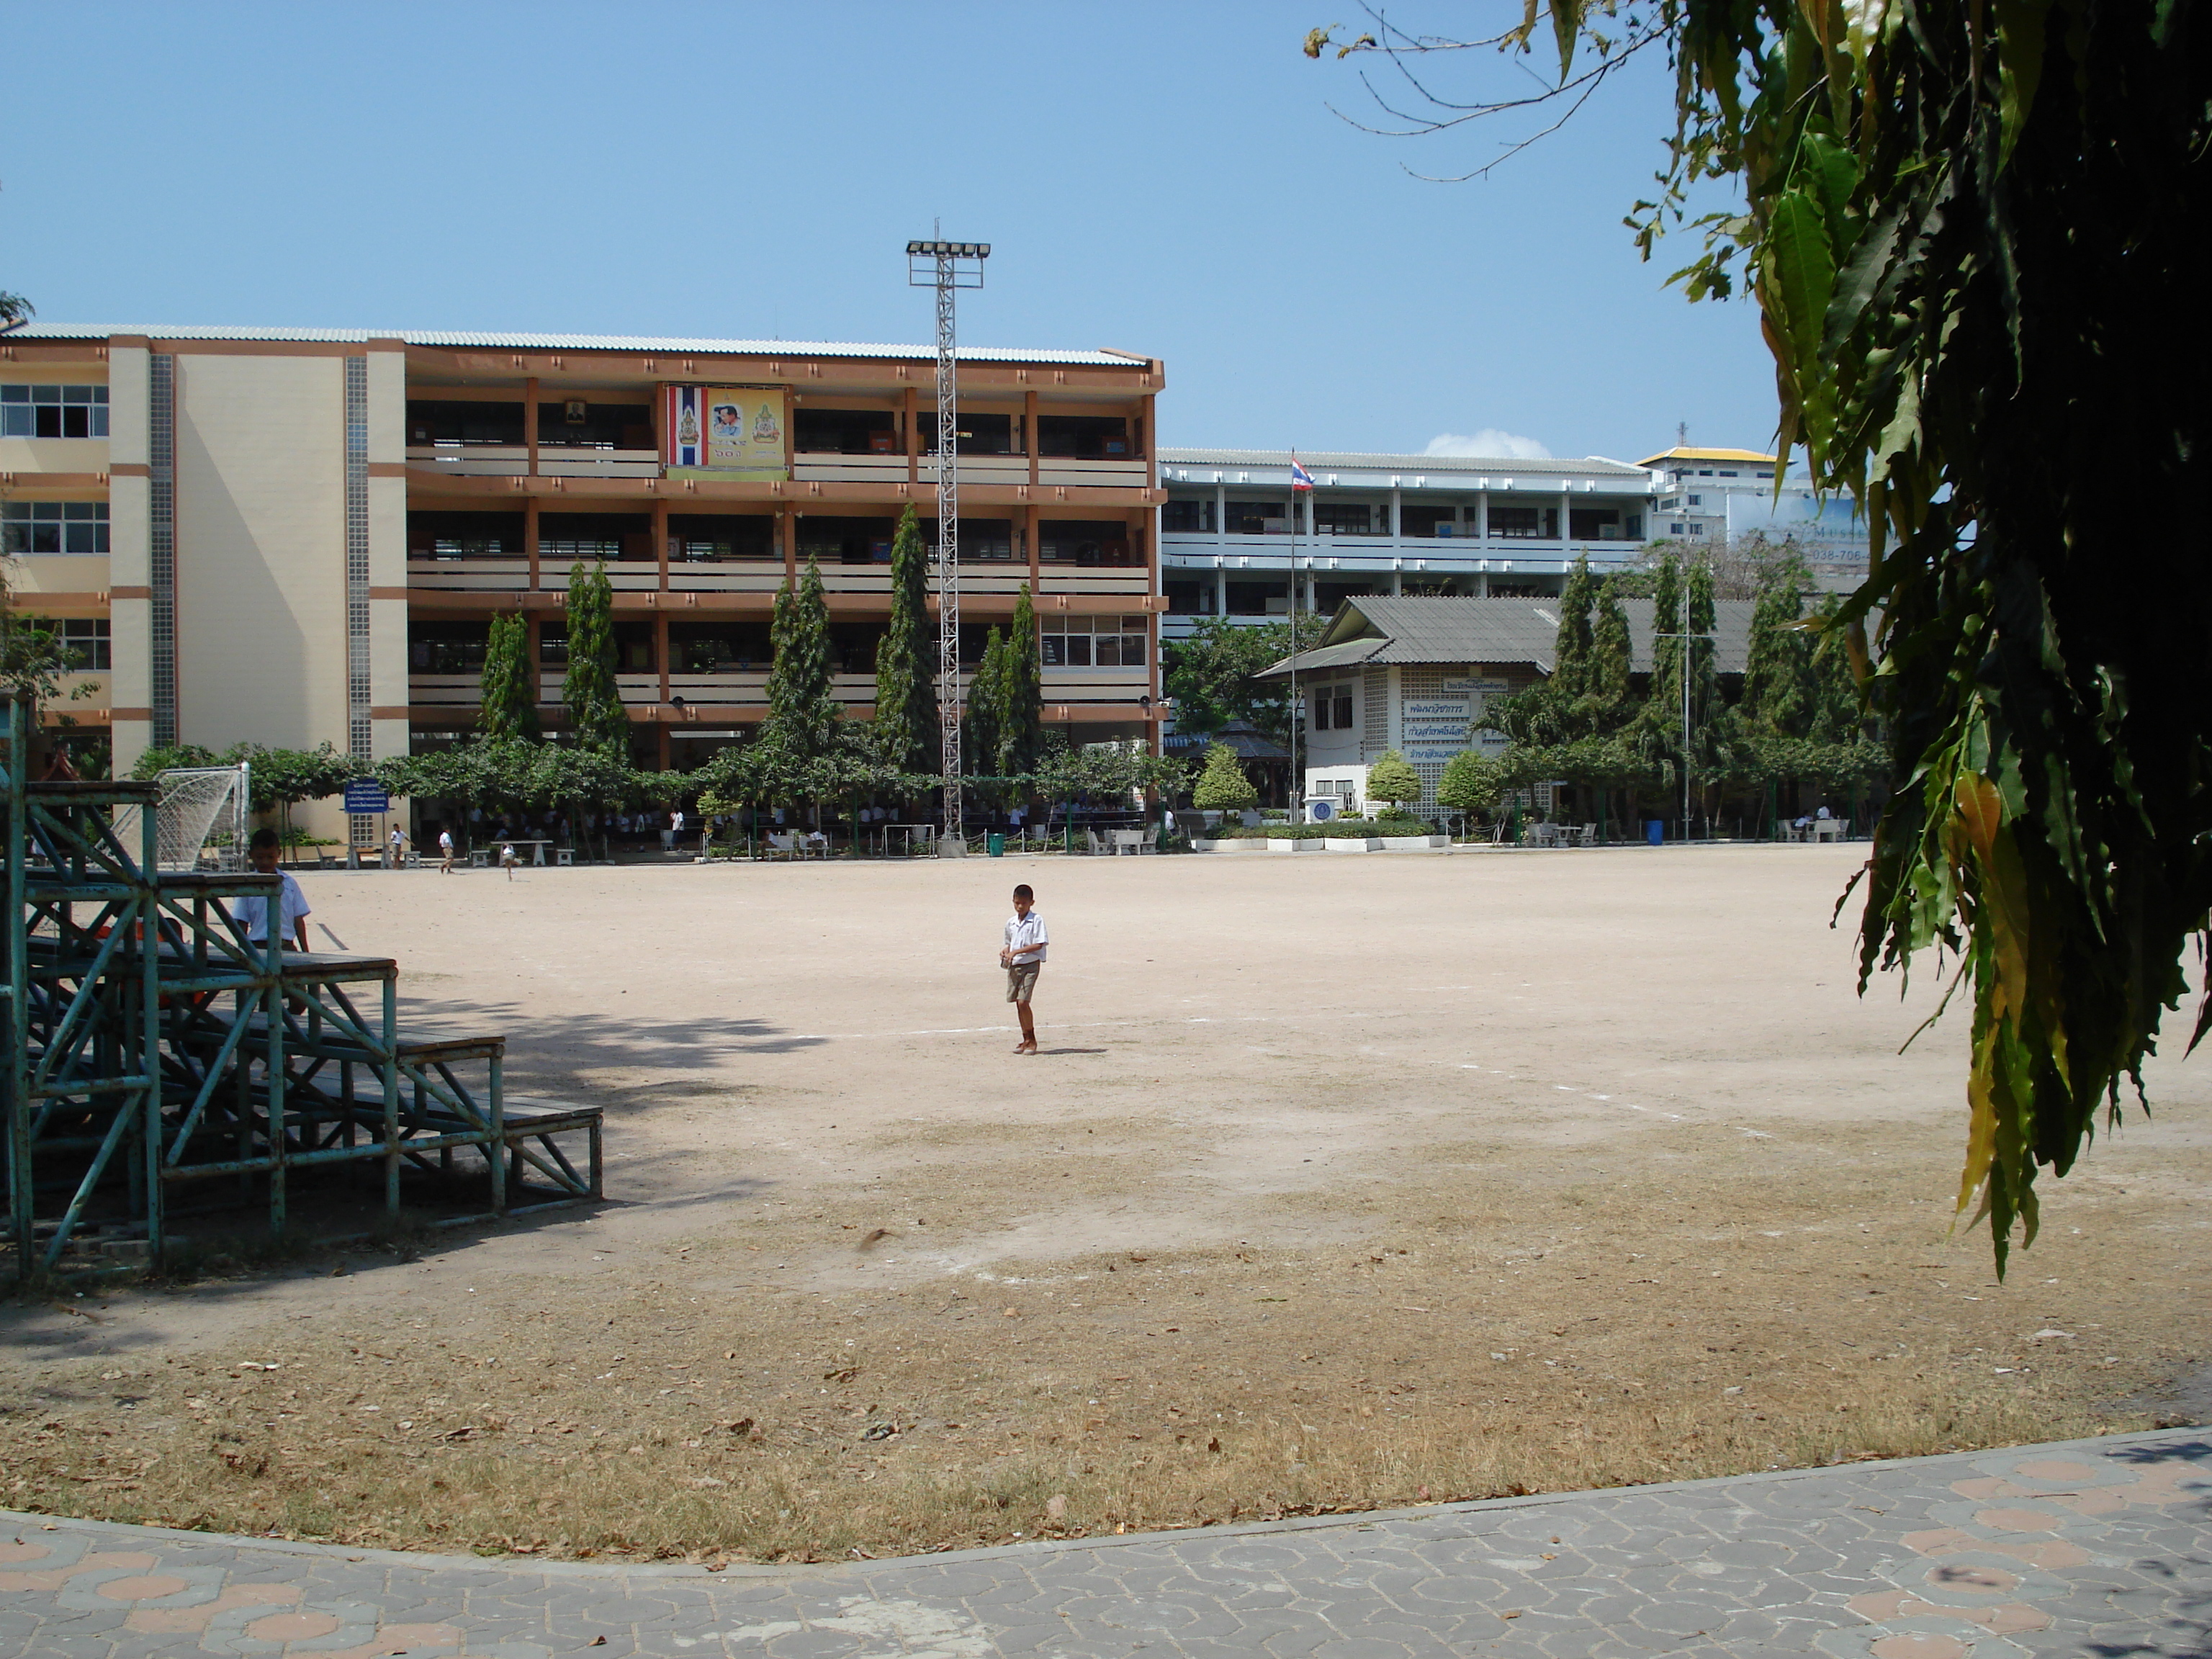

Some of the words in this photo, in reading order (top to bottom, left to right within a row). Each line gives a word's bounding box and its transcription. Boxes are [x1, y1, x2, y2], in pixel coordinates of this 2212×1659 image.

[1813, 550, 1883, 560] 038-706-
[1410, 703, 1464, 714] พัฒนาวิชาการ
